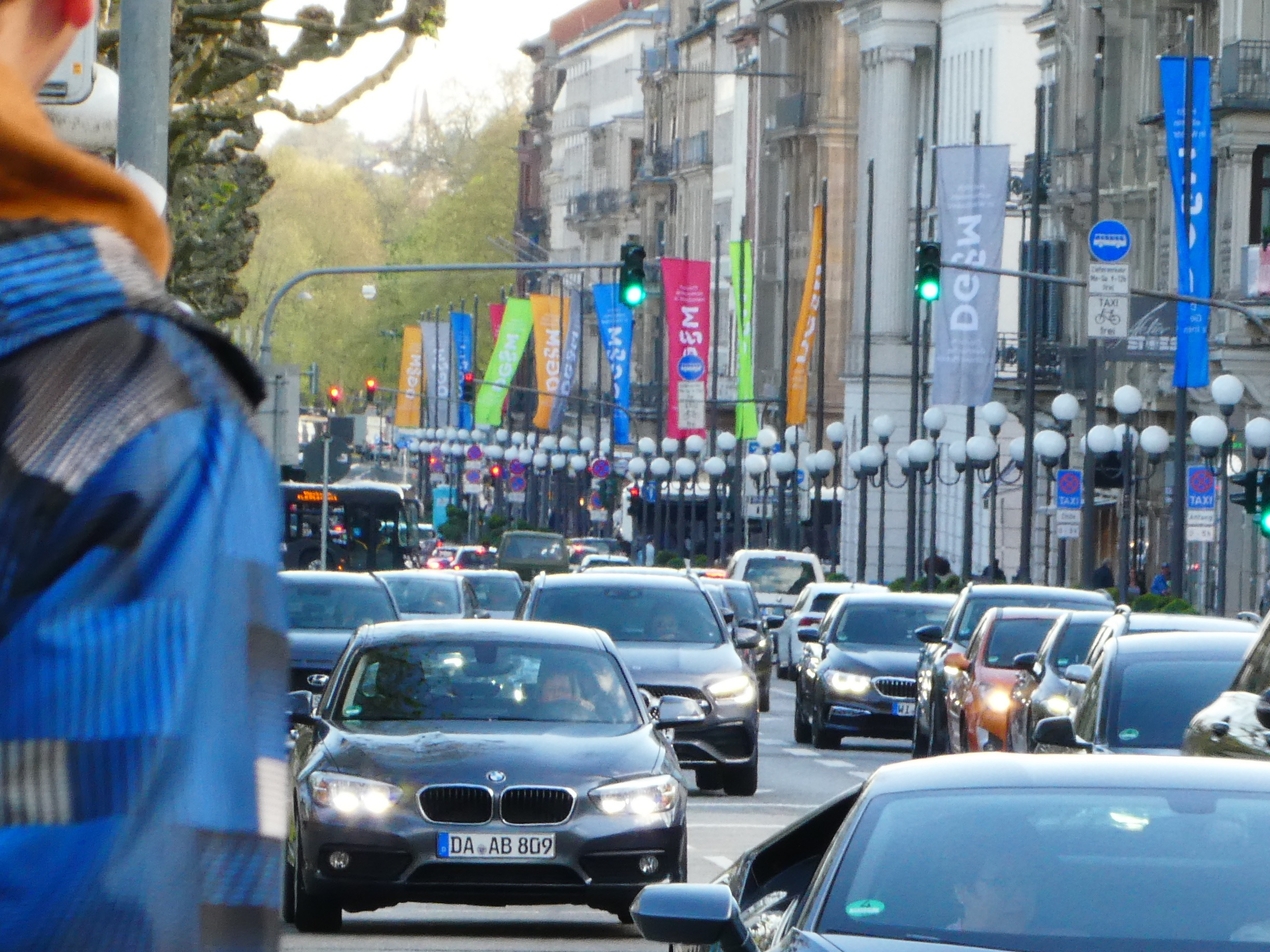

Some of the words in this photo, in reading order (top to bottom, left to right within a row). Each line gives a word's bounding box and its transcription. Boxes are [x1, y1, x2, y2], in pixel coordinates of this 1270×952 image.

[1099, 298, 1118, 306] TAXI
[1059, 496, 1079, 505] TAXI
[1190, 495, 1213, 505] TAXI
[451, 836, 474, 854] DA
[489, 837, 512, 855] AB
[518, 837, 553, 855] 809
